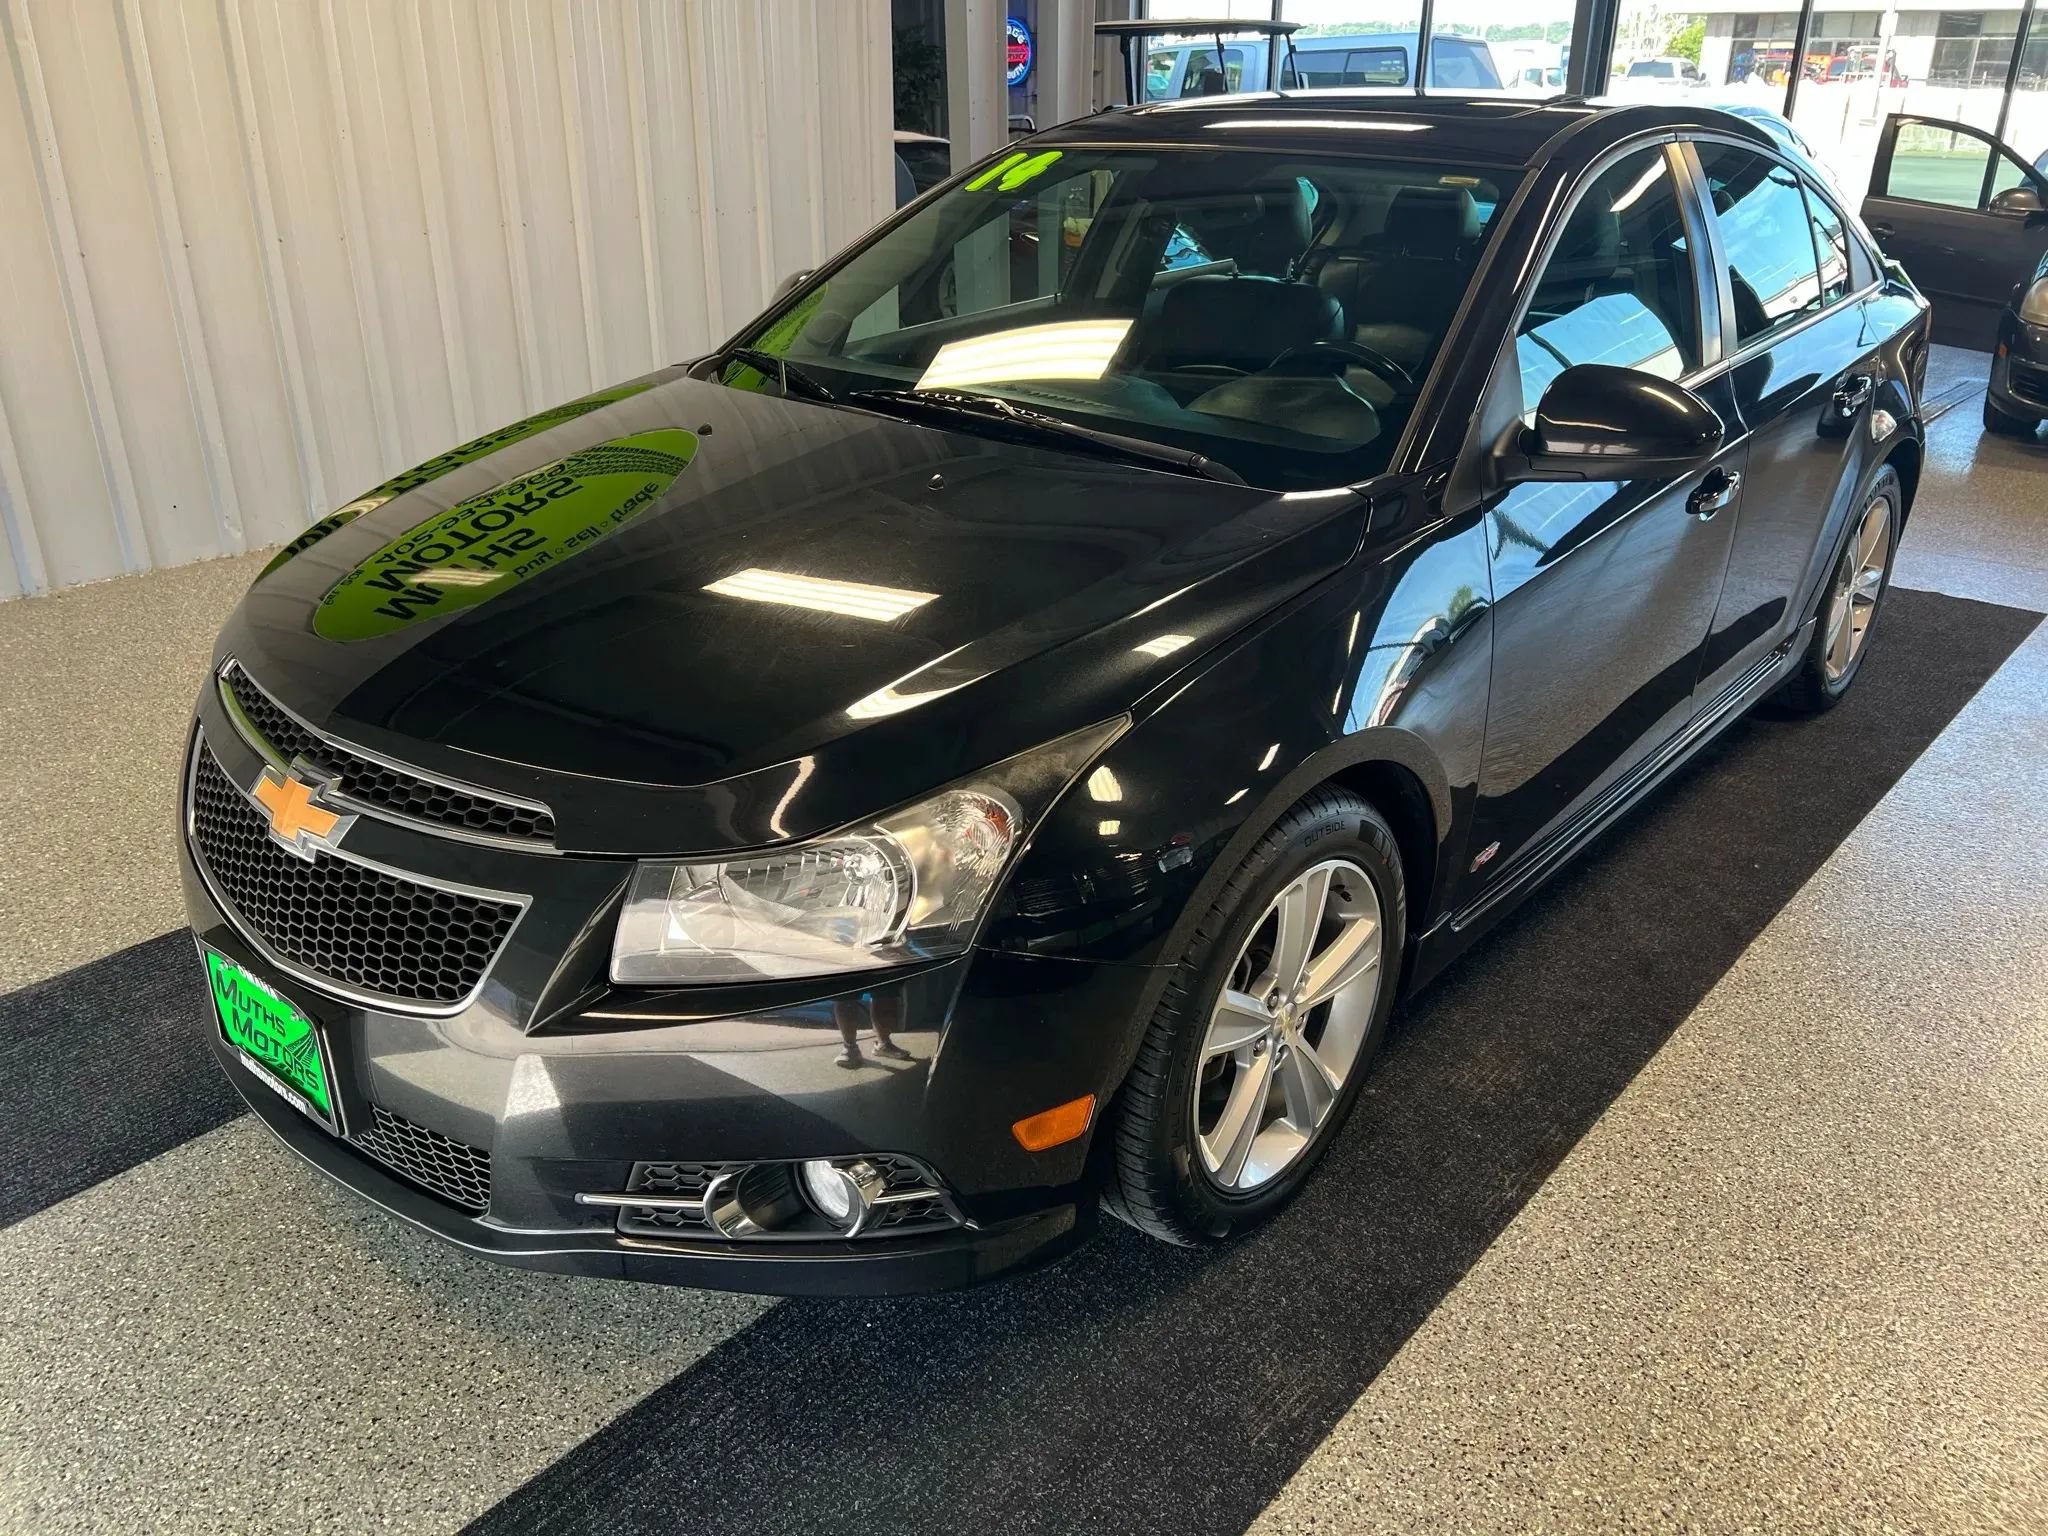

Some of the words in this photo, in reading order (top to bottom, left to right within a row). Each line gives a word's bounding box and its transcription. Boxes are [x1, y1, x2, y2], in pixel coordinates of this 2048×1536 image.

[1304, 821, 1346, 847] OUTSIDE
[216, 969, 287, 1038] MUTHS
[232, 1007, 320, 1090] MOTORS
